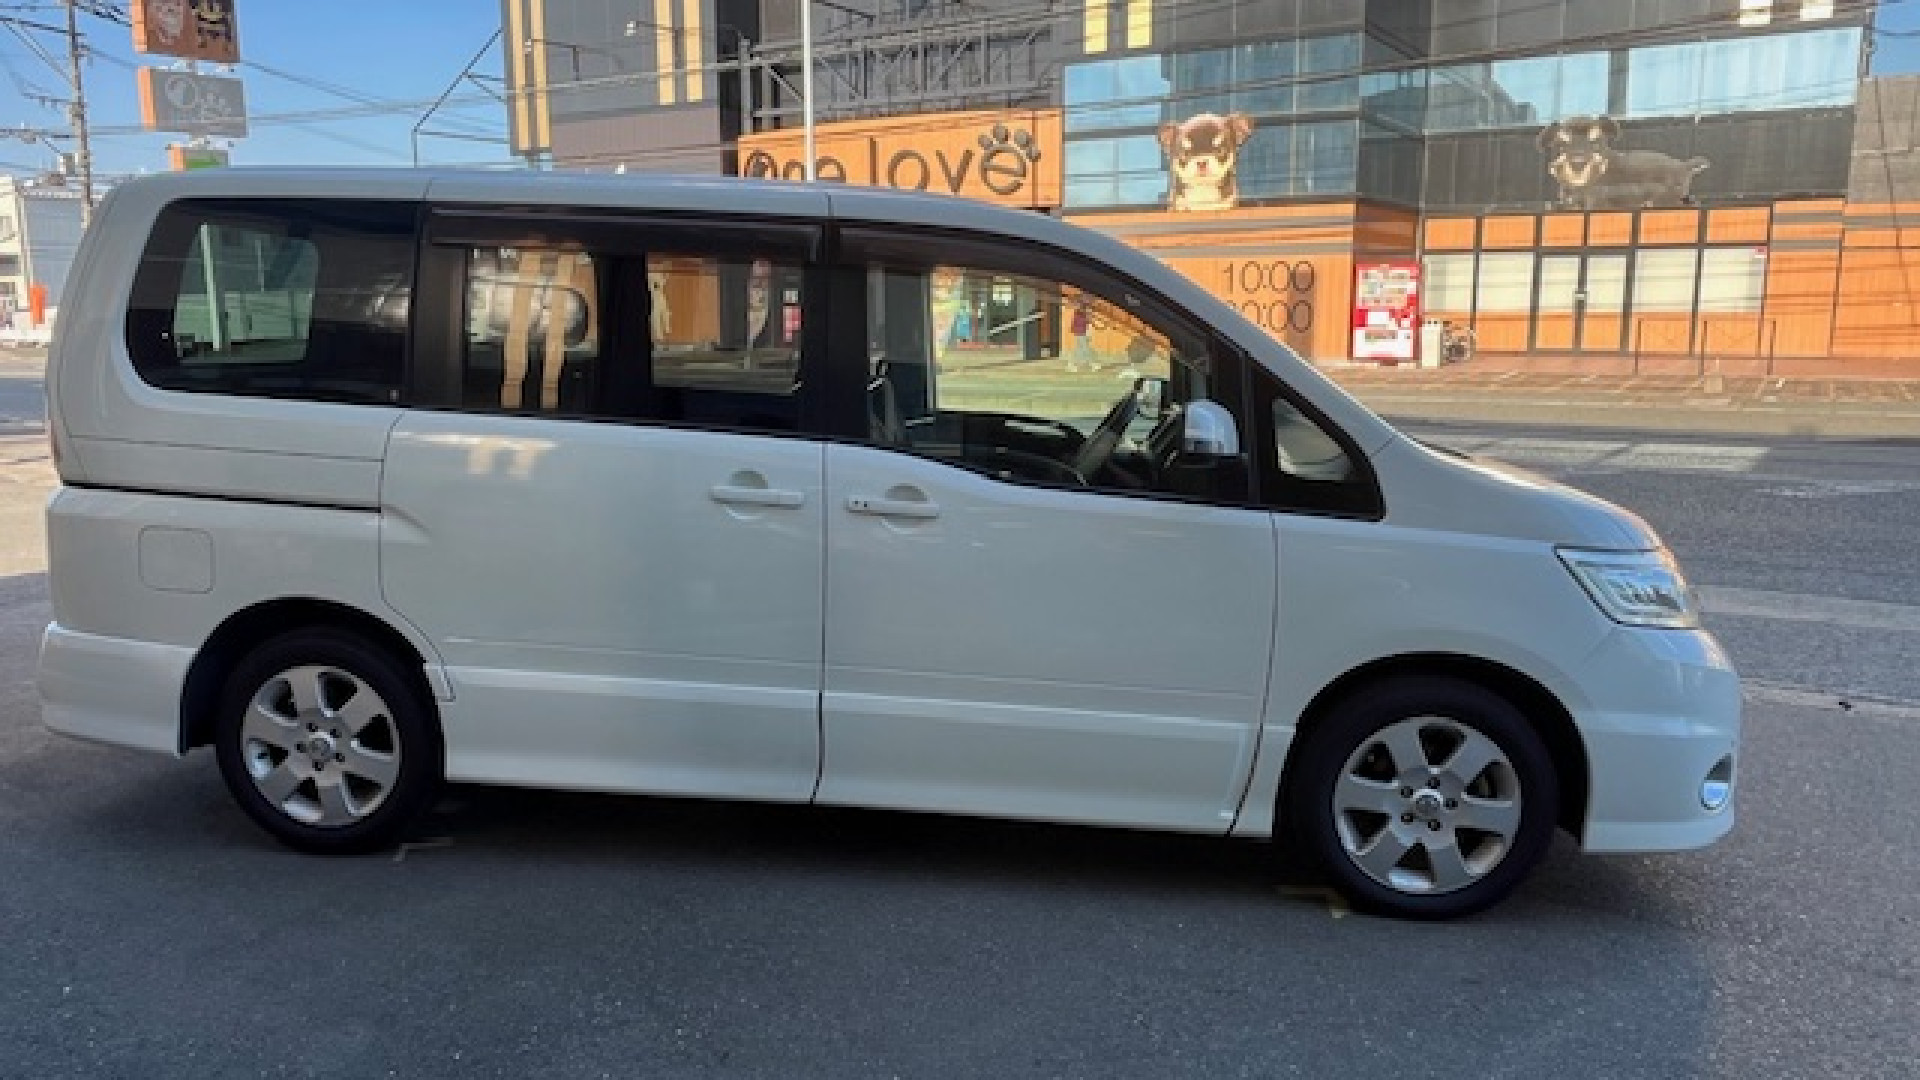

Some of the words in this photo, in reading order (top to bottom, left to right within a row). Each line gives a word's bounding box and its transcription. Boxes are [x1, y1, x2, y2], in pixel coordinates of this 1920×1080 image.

[868, 134, 1028, 195] love
[1222, 260, 1315, 294] 10:00
[1227, 300, 1313, 334] 0:00
